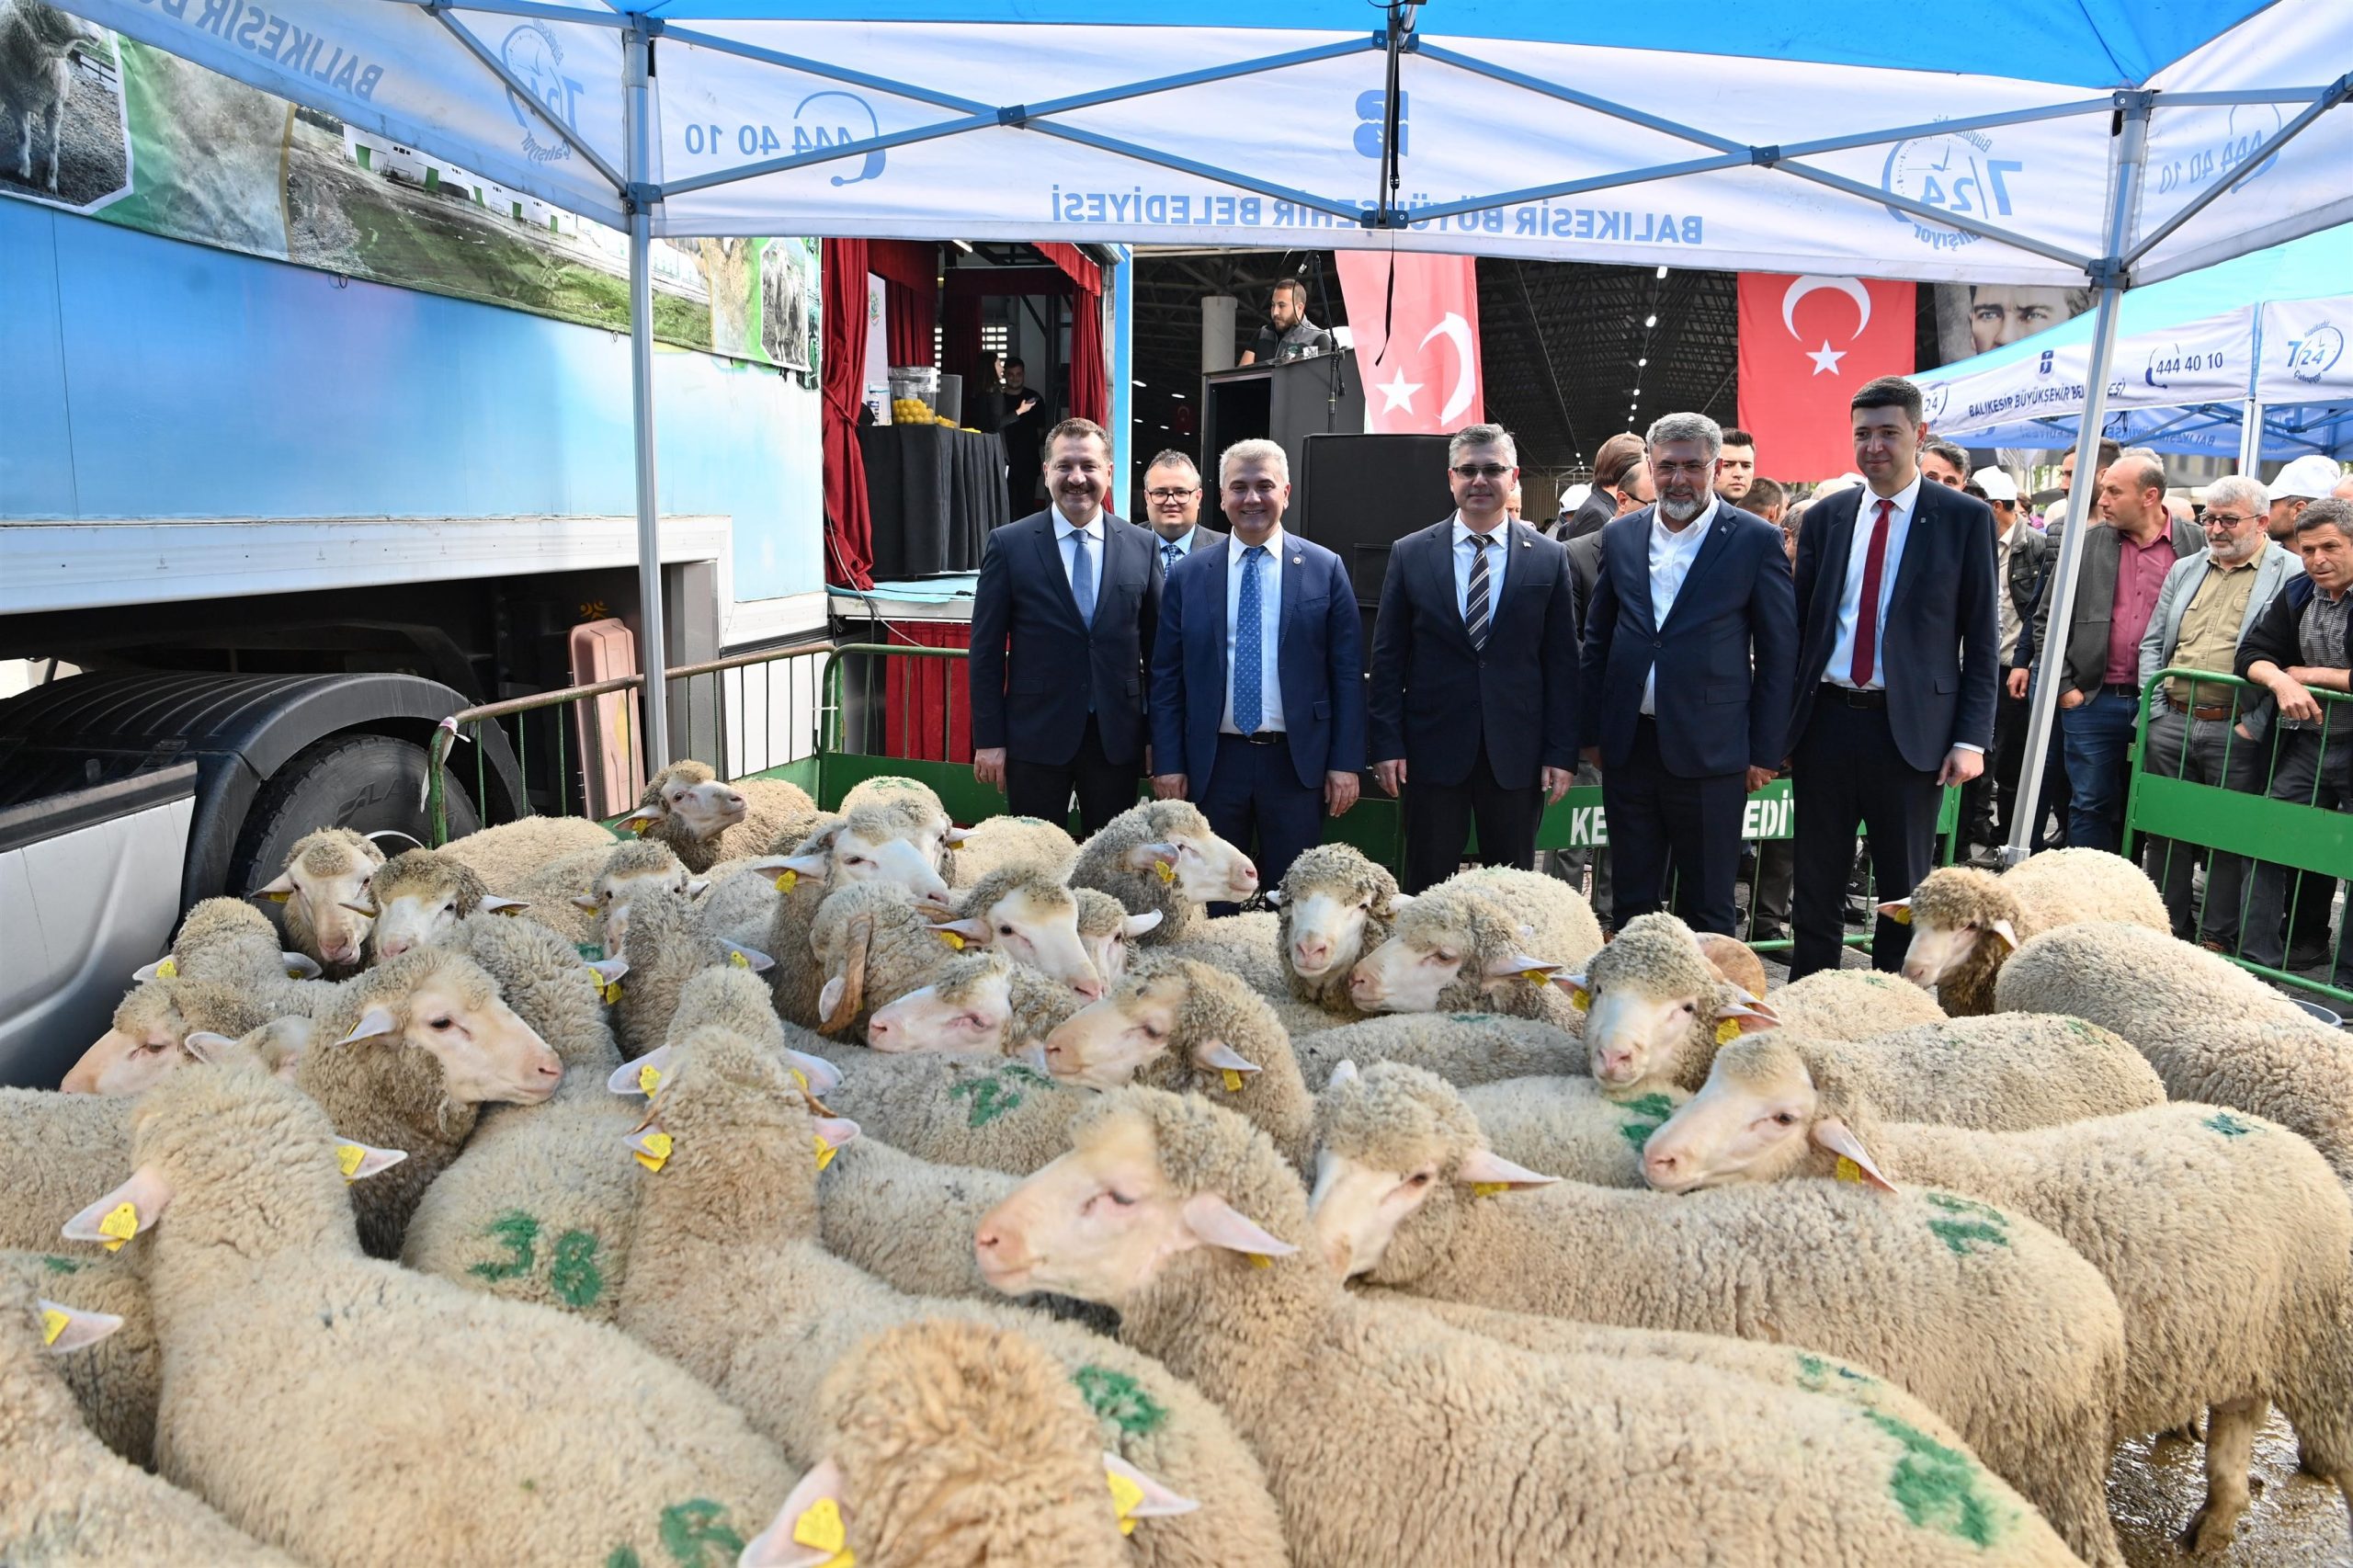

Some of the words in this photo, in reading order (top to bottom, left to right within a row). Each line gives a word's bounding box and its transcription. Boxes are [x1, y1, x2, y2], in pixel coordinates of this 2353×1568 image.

[2156, 358, 2180, 375] 444
[2185, 355, 2201, 371] 40
[2207, 352, 2222, 369] 10
